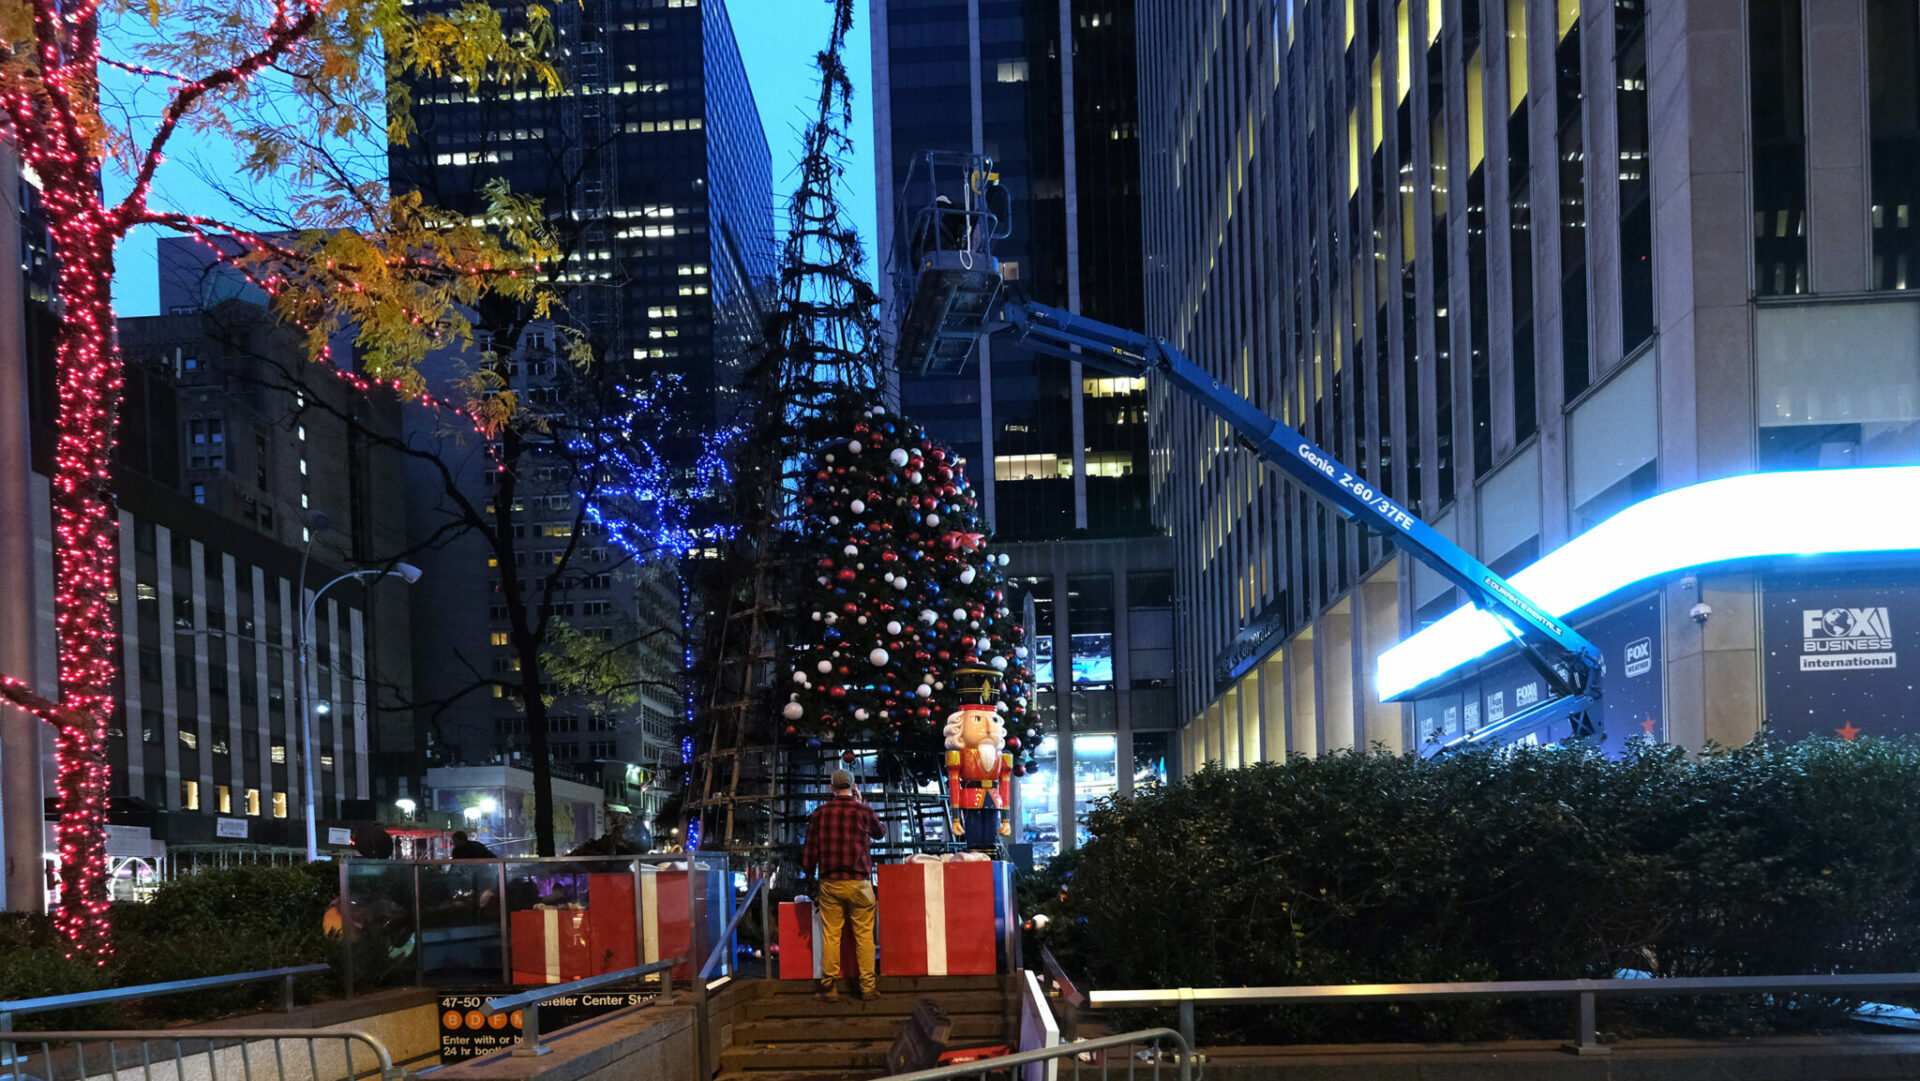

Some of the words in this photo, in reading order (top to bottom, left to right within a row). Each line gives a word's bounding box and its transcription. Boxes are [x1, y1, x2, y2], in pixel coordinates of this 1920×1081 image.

[1298, 443, 1335, 478] Genie
[1338, 472, 1415, 531] Z-60/37FE
[1627, 642, 1649, 662] FOX
[1803, 639, 1893, 652] BUSINESS
[1803, 656, 1893, 669] international
[442, 996, 481, 1008] 47-50
[582, 995, 625, 1006] Center
[442, 1035, 470, 1046] Enter
[473, 1035, 496, 1045] with
[499, 1036, 510, 1044] or
[443, 1046, 457, 1056] 24
[460, 1046, 471, 1056] hr
